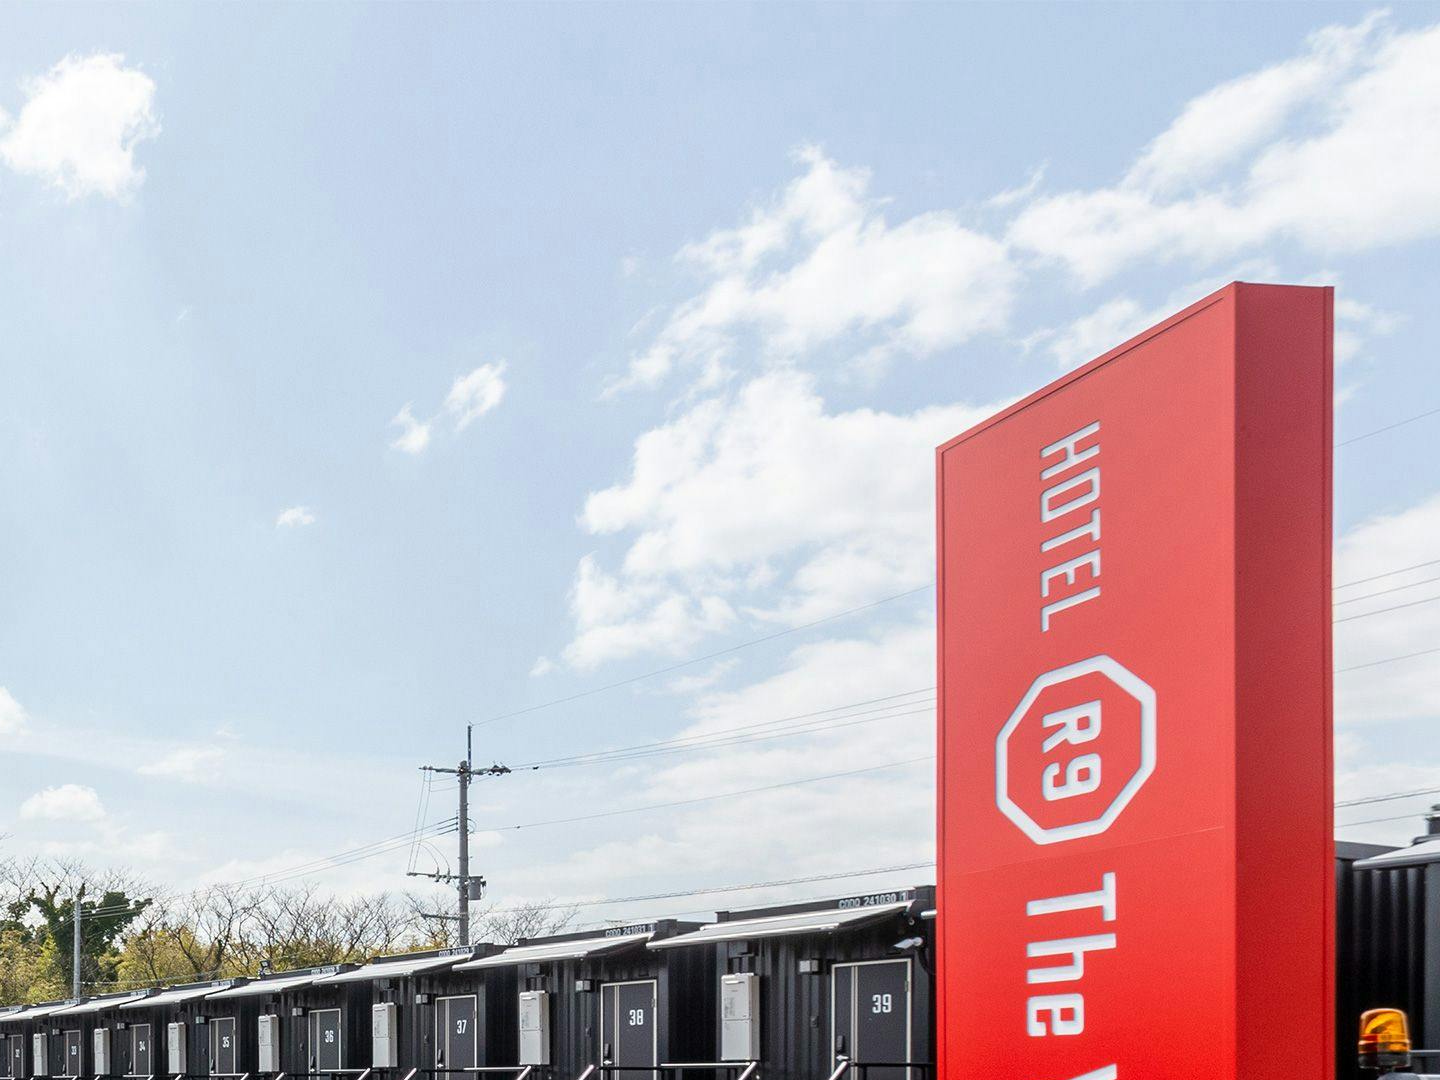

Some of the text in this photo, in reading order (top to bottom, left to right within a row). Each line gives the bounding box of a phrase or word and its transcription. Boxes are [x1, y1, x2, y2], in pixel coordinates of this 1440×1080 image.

[1040, 420, 1101, 633] HOTEL
[1042, 699, 1102, 802] R9
[1027, 872, 1117, 1037] The
[872, 993, 892, 1013] 39
[456, 1019, 467, 1034] 37
[629, 1009, 643, 1026] 38
[222, 1036, 230, 1048] 35
[324, 1030, 334, 1043] 36
